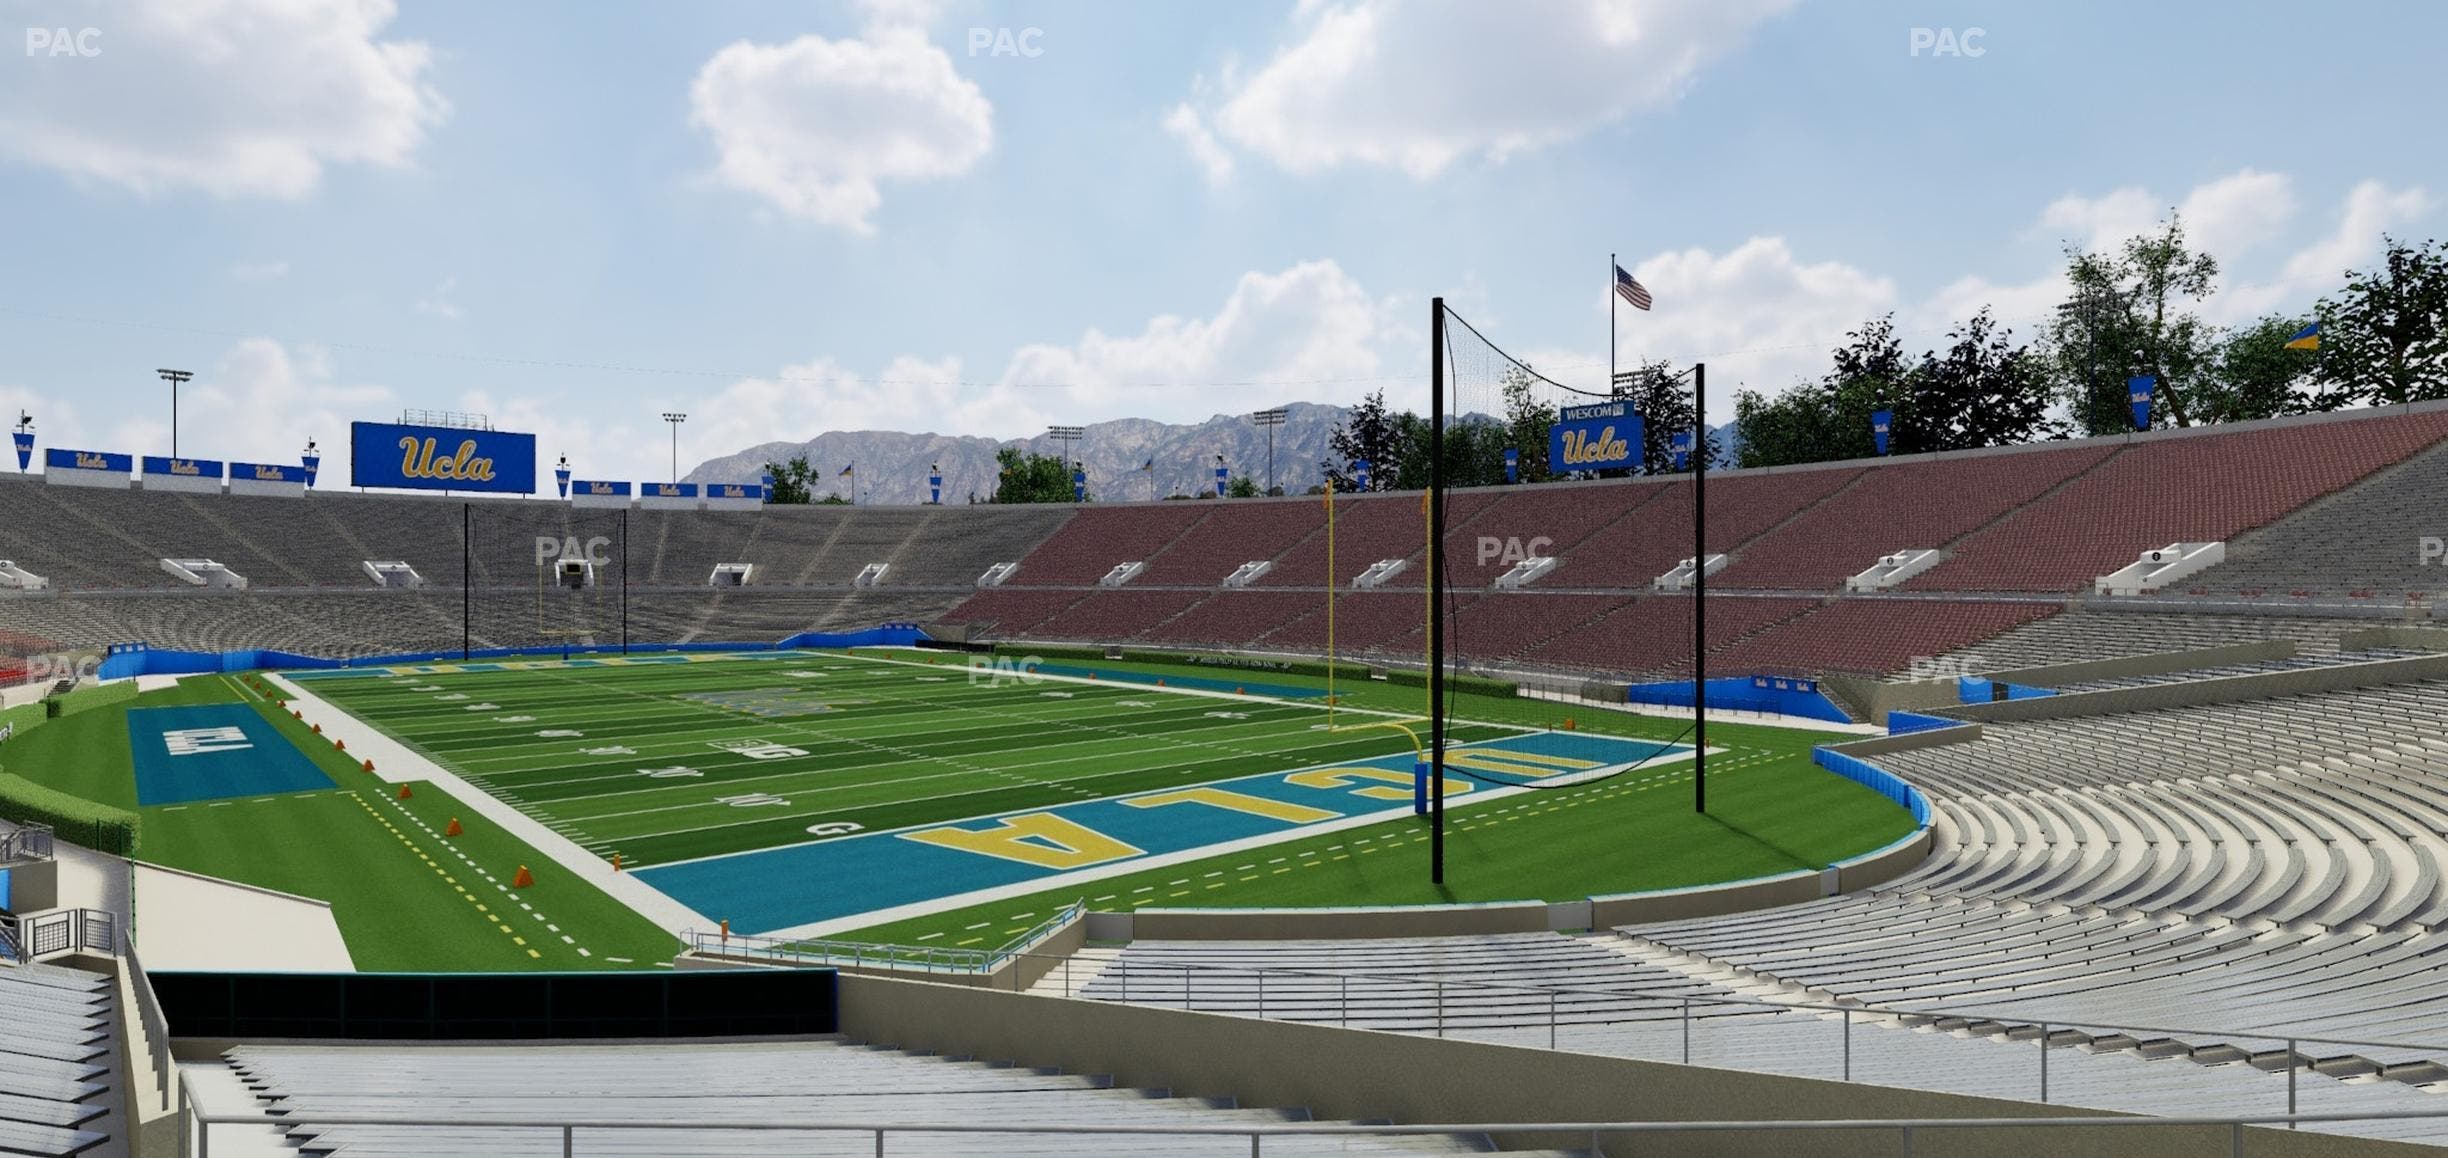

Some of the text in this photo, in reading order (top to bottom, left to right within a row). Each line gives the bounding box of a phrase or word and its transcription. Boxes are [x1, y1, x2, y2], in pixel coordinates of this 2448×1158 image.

[1566, 406, 1612, 420] WESCOM
[399, 436, 496, 482] Ucla
[1562, 426, 1629, 465] Ucla
